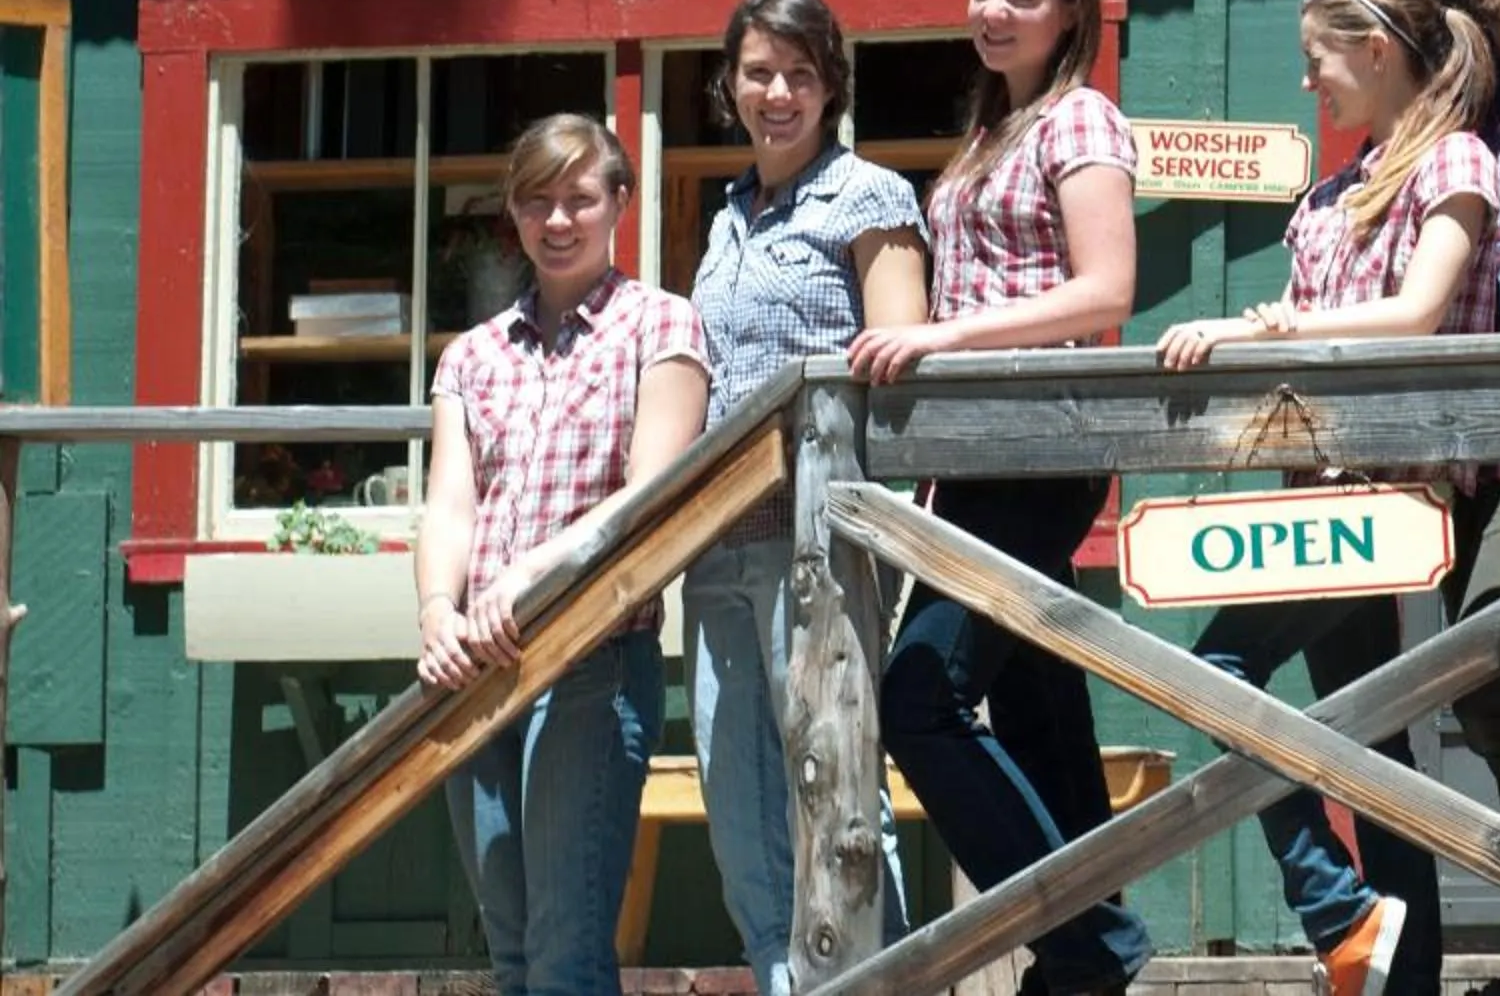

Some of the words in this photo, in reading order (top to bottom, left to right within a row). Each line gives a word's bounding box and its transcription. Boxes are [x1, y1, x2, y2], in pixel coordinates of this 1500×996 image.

[1150, 130, 1267, 155] WORSHIP
[1151, 155, 1262, 181] SERVICES
[1190, 515, 1375, 573] OPEN
